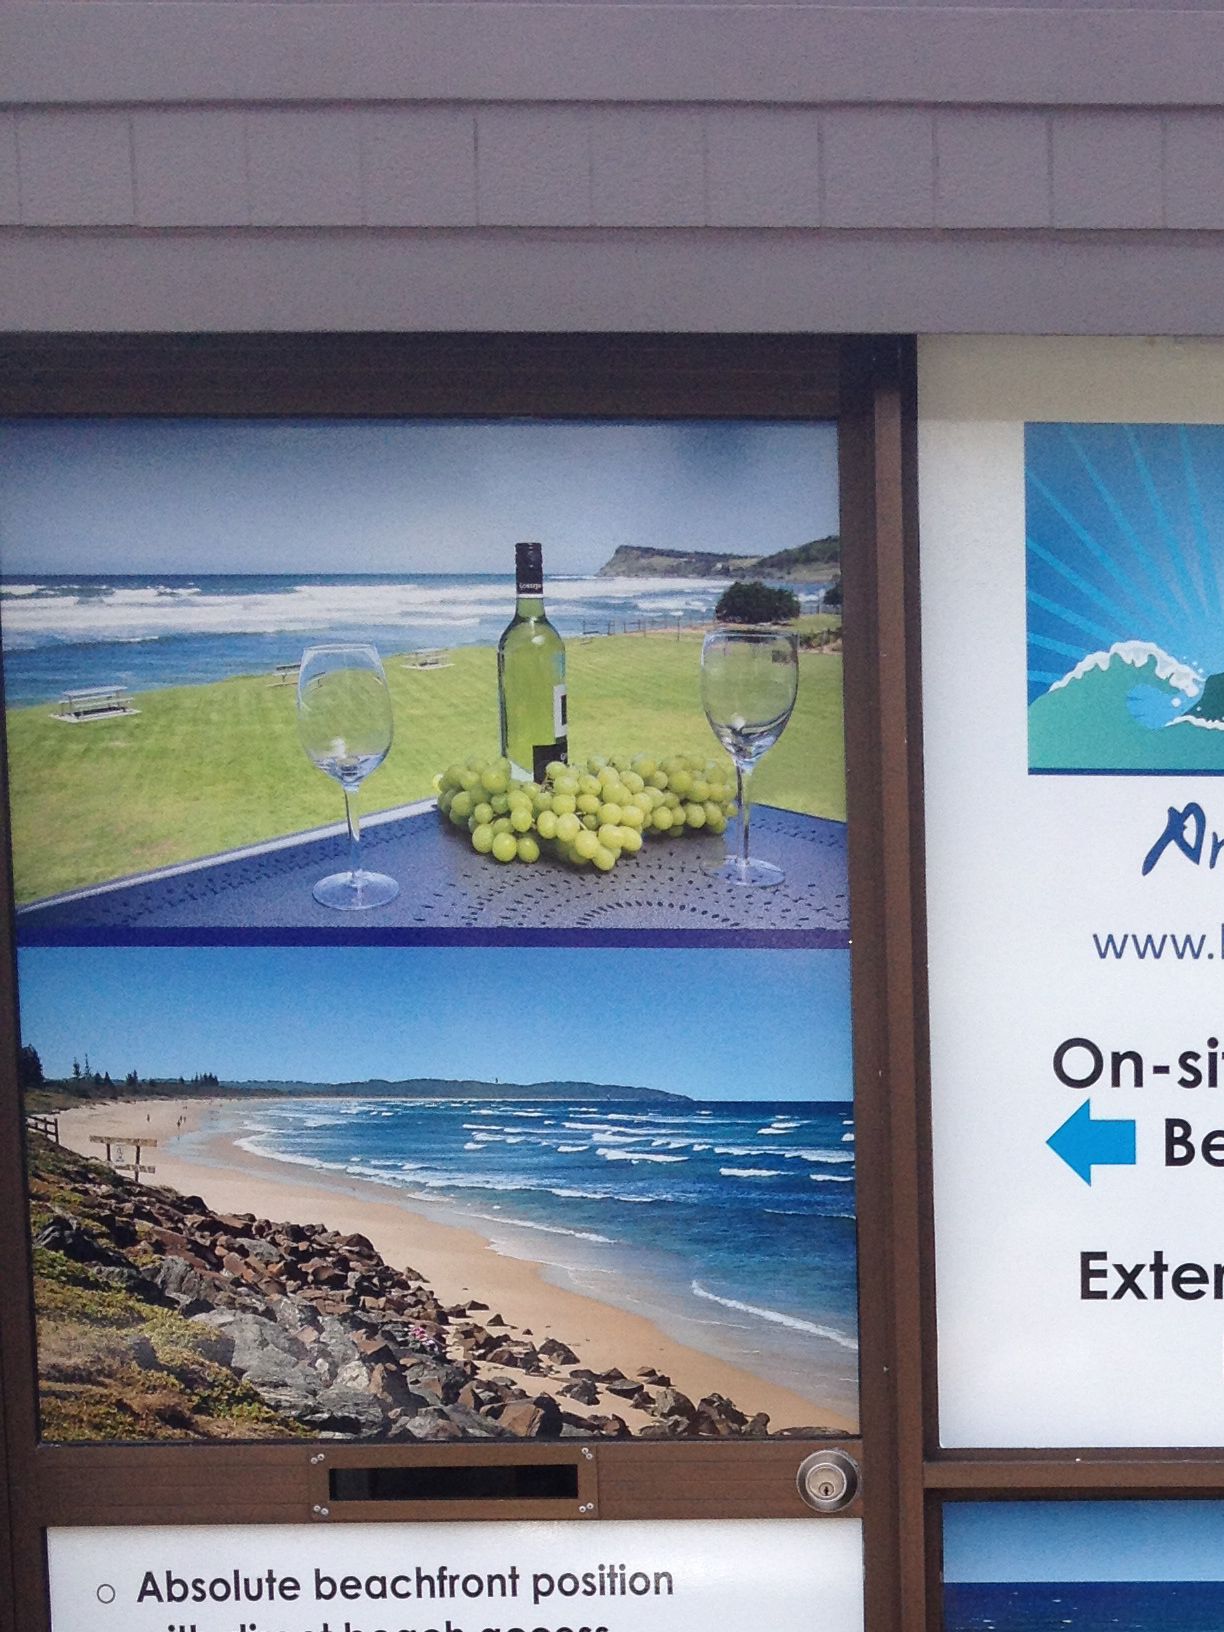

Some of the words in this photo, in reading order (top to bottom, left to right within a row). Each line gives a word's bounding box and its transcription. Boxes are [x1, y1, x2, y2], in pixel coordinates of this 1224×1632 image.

[137, 1569, 300, 1603] Absolute
[315, 1566, 520, 1600] beachfront
[533, 1564, 673, 1604] position
